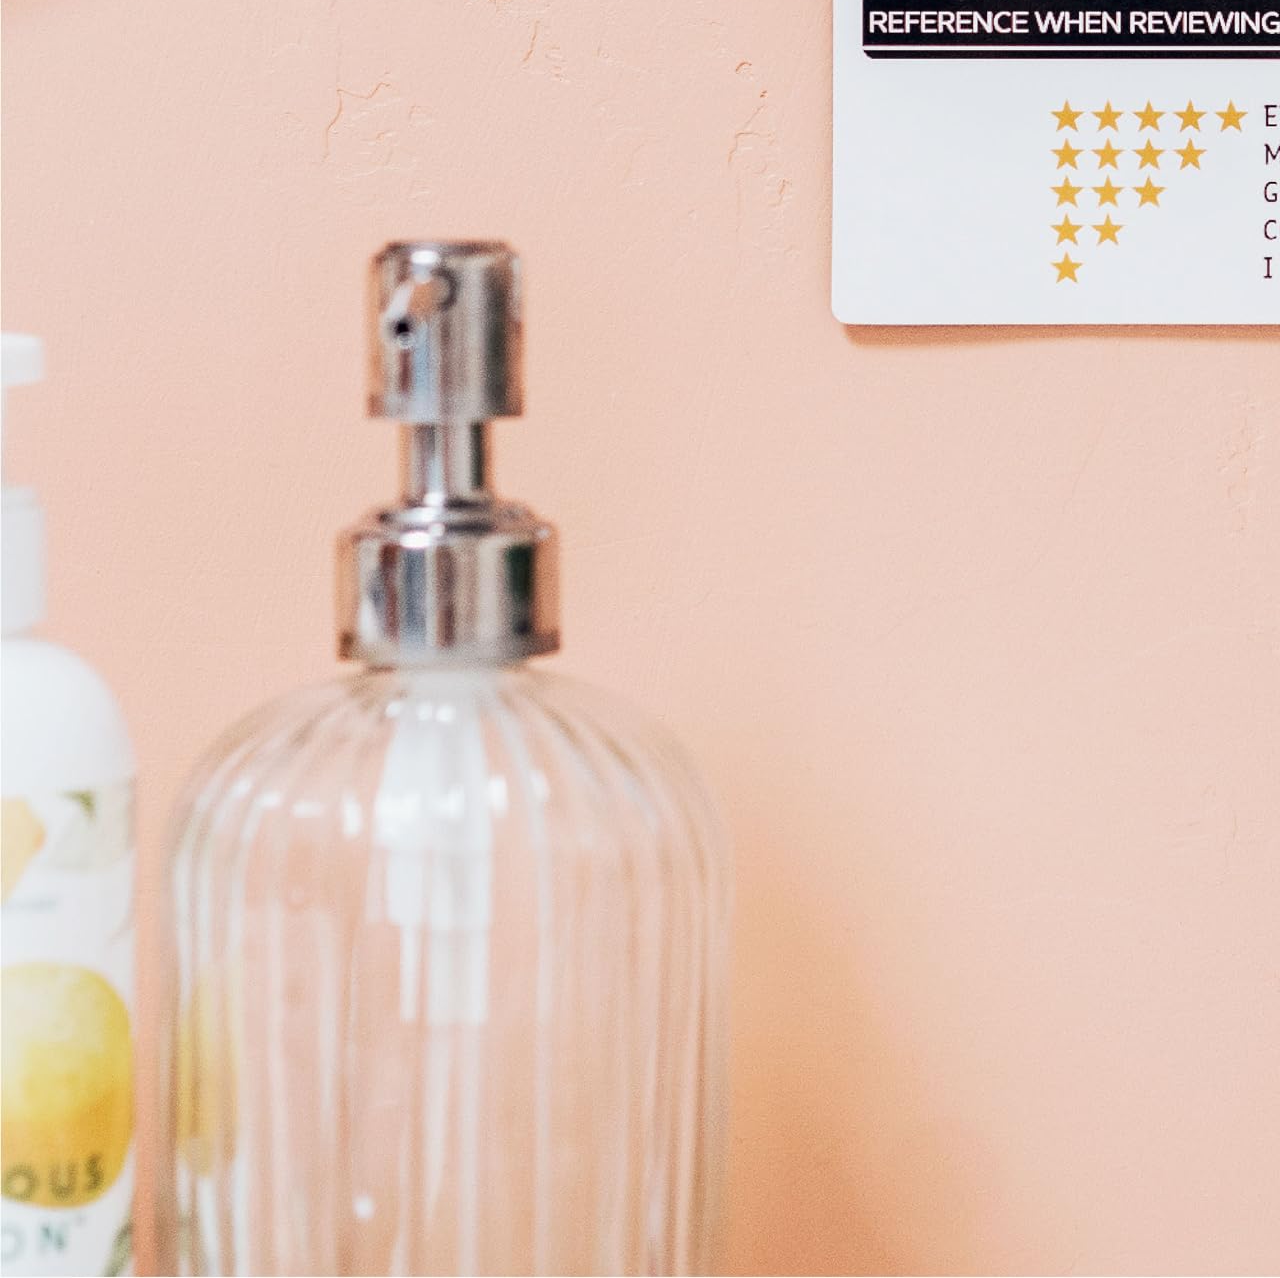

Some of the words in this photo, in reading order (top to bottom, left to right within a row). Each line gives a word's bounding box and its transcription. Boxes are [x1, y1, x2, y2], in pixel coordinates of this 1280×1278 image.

[869, 10, 1030, 34] REFERENCE
[1034, 10, 1122, 34] WHEN
[1129, 10, 1280, 35] REVIEWING
[1263, 256, 1273, 279] I
